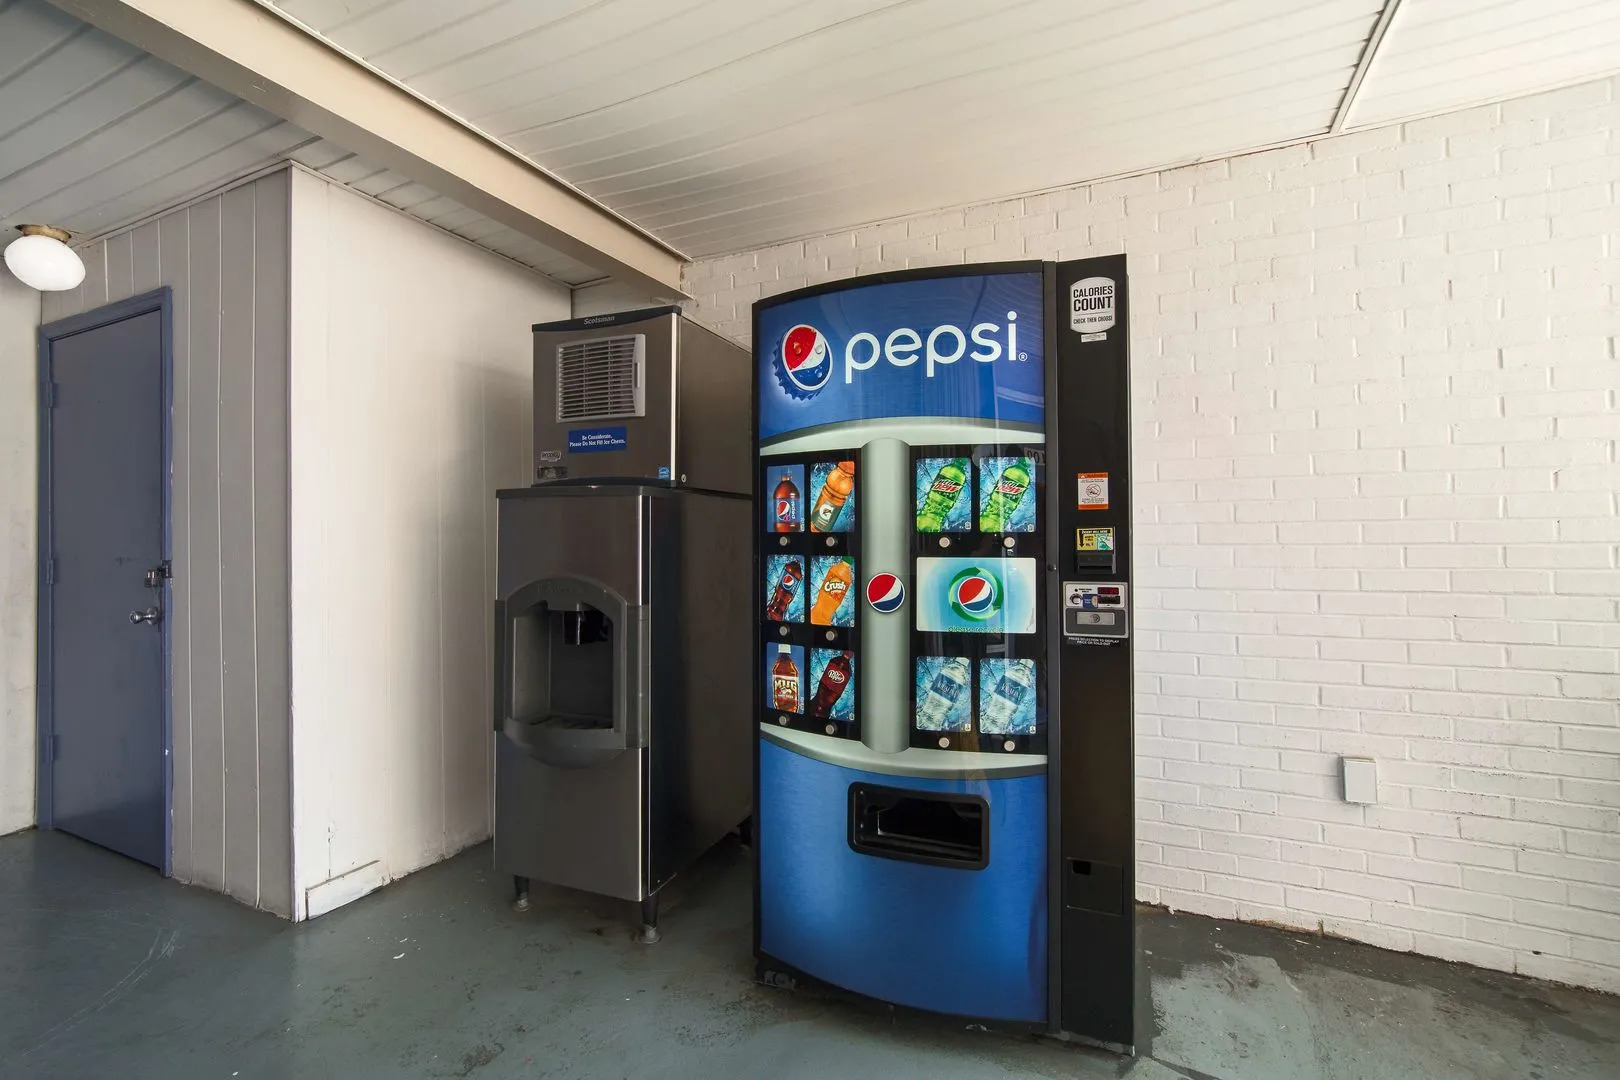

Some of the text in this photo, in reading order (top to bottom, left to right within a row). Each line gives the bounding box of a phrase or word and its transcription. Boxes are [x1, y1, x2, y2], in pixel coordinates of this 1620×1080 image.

[1073, 285, 1113, 298] CALORIES
[1073, 296, 1113, 311] COUNT
[583, 315, 615, 326] Scotsman
[845, 310, 1018, 384] pepsi
[824, 580, 847, 592] Crush
[774, 679, 797, 690] MUG
